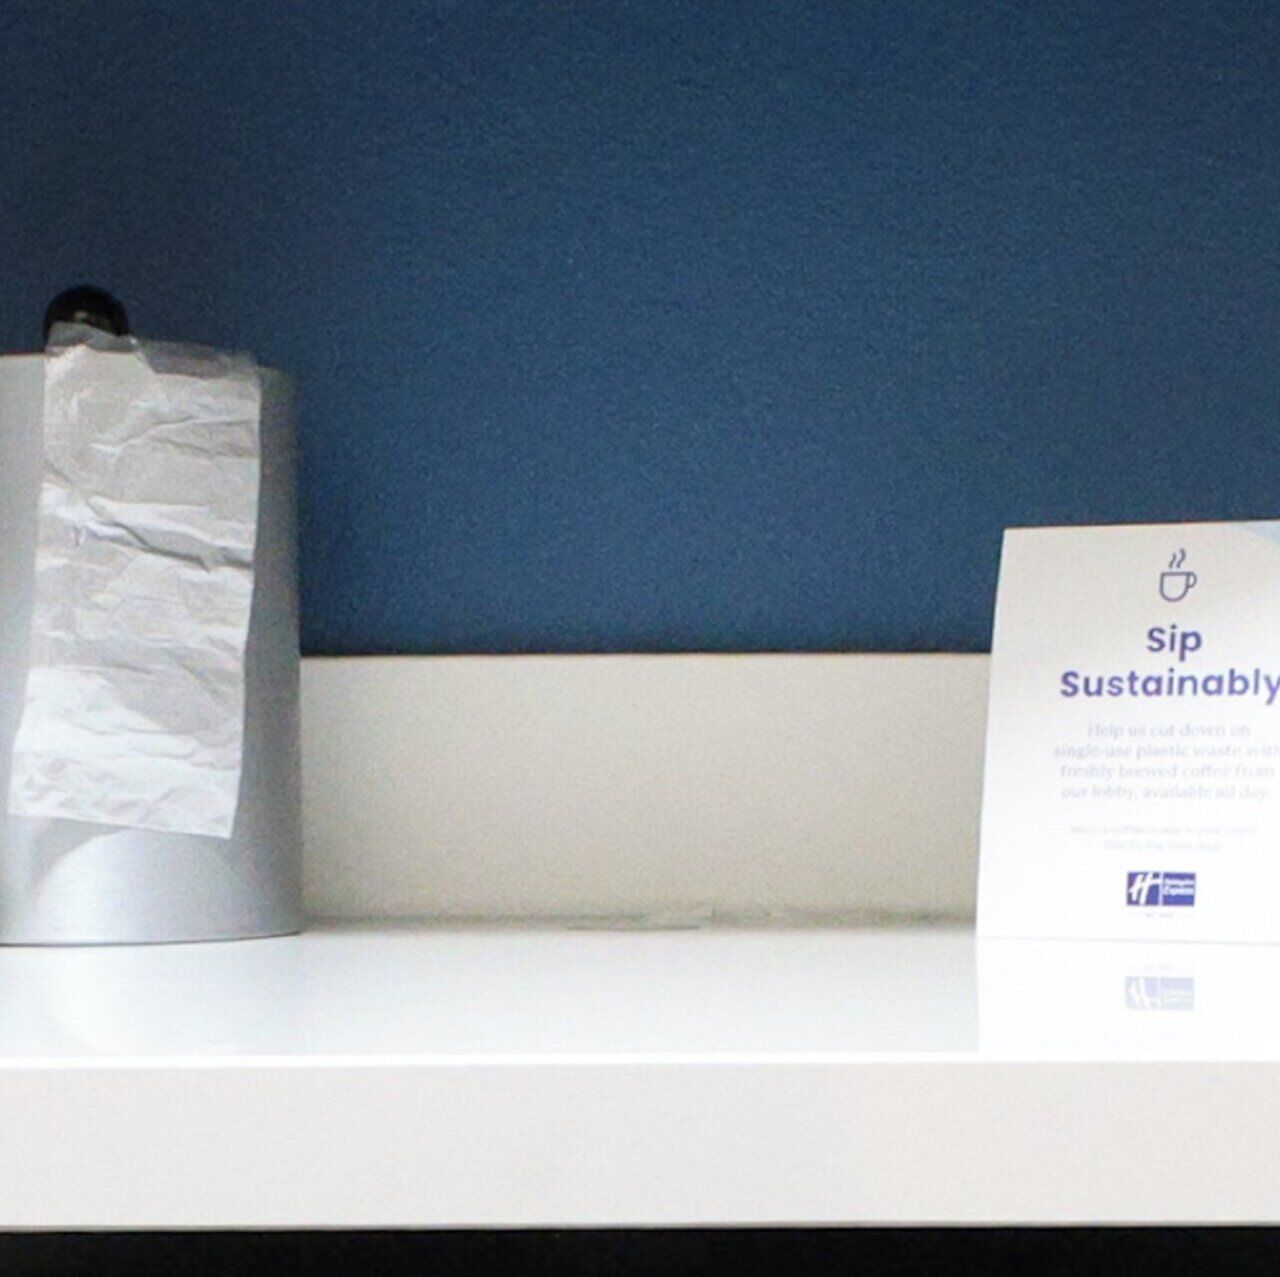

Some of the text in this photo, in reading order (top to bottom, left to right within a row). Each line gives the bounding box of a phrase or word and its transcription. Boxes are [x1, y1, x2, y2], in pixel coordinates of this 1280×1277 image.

[1146, 624, 1202, 661] Sip
[1150, 725, 1175, 737] cut
[1179, 723, 1225, 736] down
[1118, 764, 1177, 777] brewed
